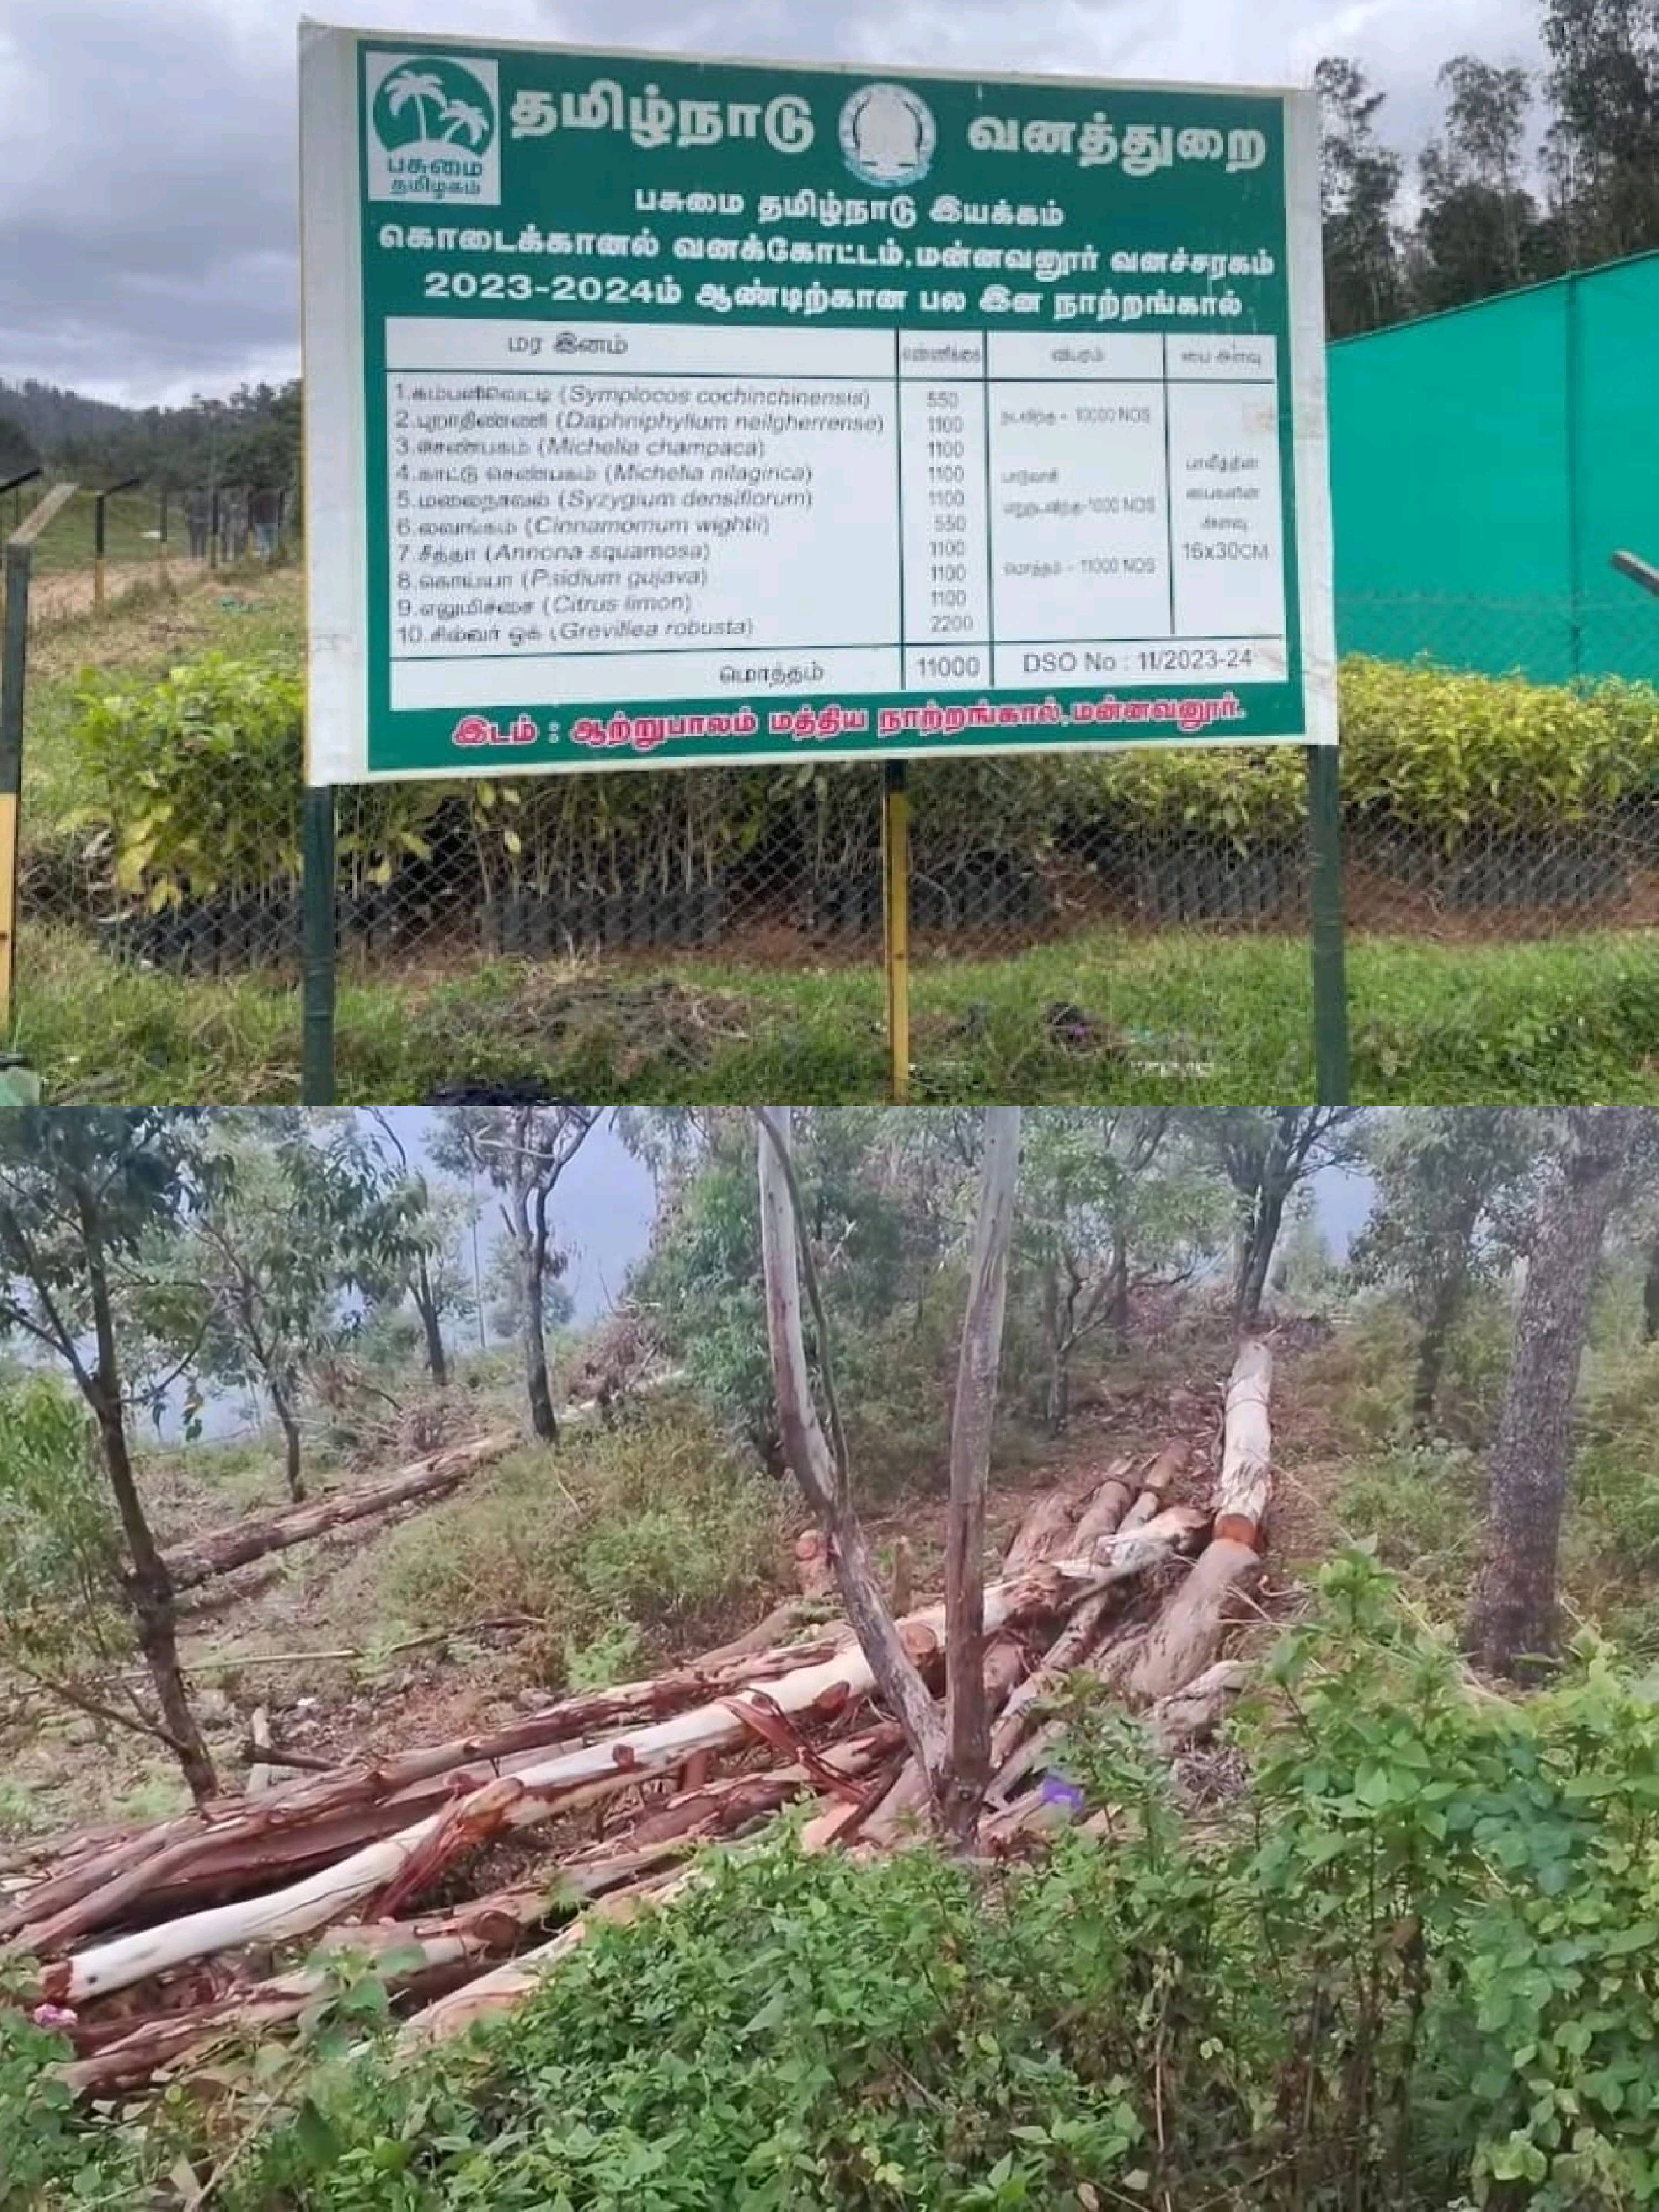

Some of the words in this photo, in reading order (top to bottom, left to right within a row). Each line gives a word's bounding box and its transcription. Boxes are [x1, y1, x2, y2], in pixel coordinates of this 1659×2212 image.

[509, 78, 815, 154] தமிழ்நாடு
[968, 111, 1266, 176] வனத்துறை
[387, 158, 483, 177] பசுமை
[390, 177, 482, 199] தமிழகம்
[636, 188, 744, 214] பசுமை
[758, 188, 916, 229] தமிழ்நாடு
[928, 194, 1064, 226] இயக்கம்
[380, 225, 659, 257] கொடைக்கானல்
[1110, 248, 1275, 281] வனச்சரகம்
[424, 272, 682, 305] 2023-2024ம்
[696, 278, 908, 316] ஆண்டிற்கான
[919, 288, 966, 312] பல
[979, 284, 1043, 314] இன
[1053, 288, 1243, 321] நாற்றங்கால்
[507, 336, 543, 355] மர
[552, 331, 629, 355] இனம்
[926, 392, 958, 409] 550
[927, 417, 963, 433] 1100
[927, 441, 964, 458] 1100
[928, 466, 964, 483] 1100
[928, 491, 964, 507] 1100
[934, 516, 966, 532] 550
[930, 540, 964, 556] 1100
[931, 565, 966, 581] 1100
[931, 590, 966, 606] 1100
[931, 616, 973, 632] 2200
[919, 658, 980, 676] 11000
[1023, 655, 1077, 672] DSO
[1084, 653, 1116, 671] No
[719, 661, 824, 688] மொத்தம்
[453, 713, 539, 747] இடம்
[568, 706, 759, 753] ஆற்றுபாலம்
[767, 703, 868, 742] மத்திய
